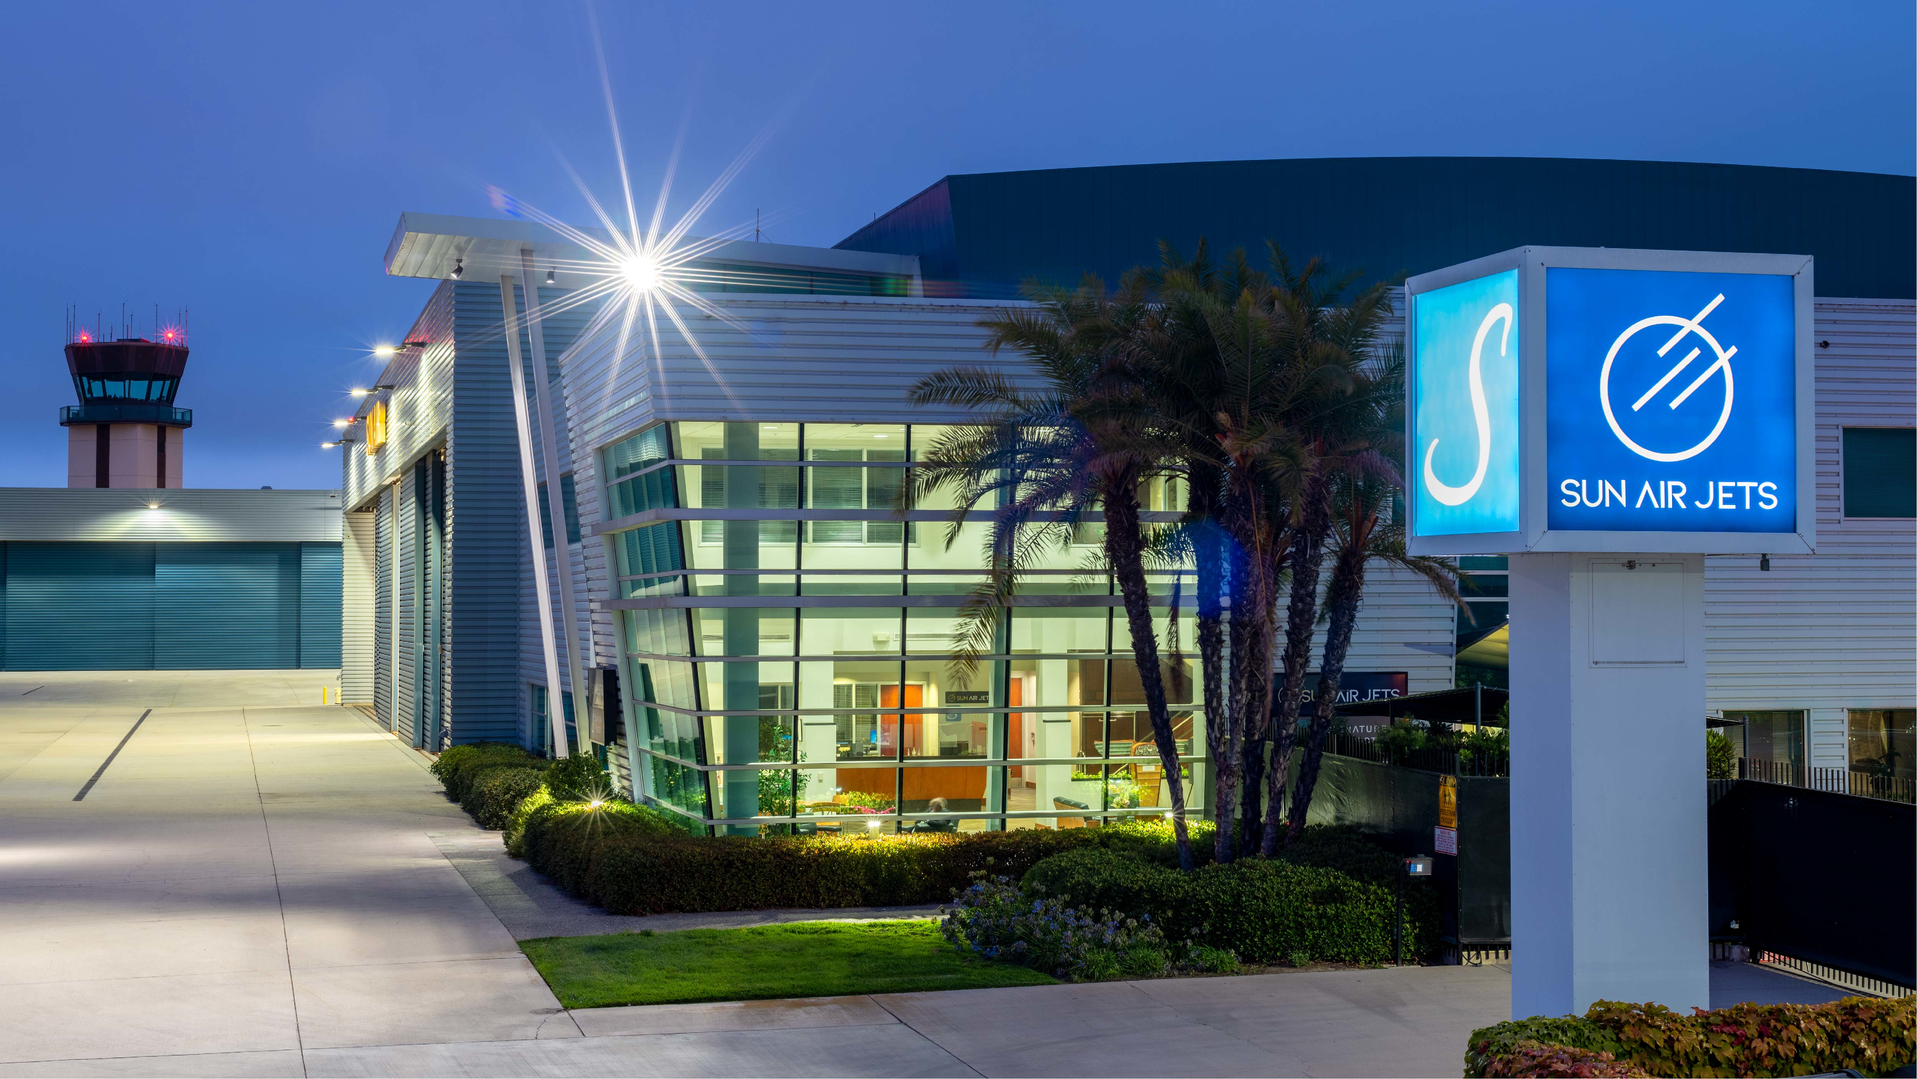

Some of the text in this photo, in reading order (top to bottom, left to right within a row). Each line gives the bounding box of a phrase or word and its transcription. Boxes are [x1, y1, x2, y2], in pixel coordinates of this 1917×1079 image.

[1424, 303, 1514, 506] S
[1561, 478, 1778, 511] SUN AIR JETS
[1335, 689, 1359, 703] AIR
[1362, 688, 1400, 702] JETS
